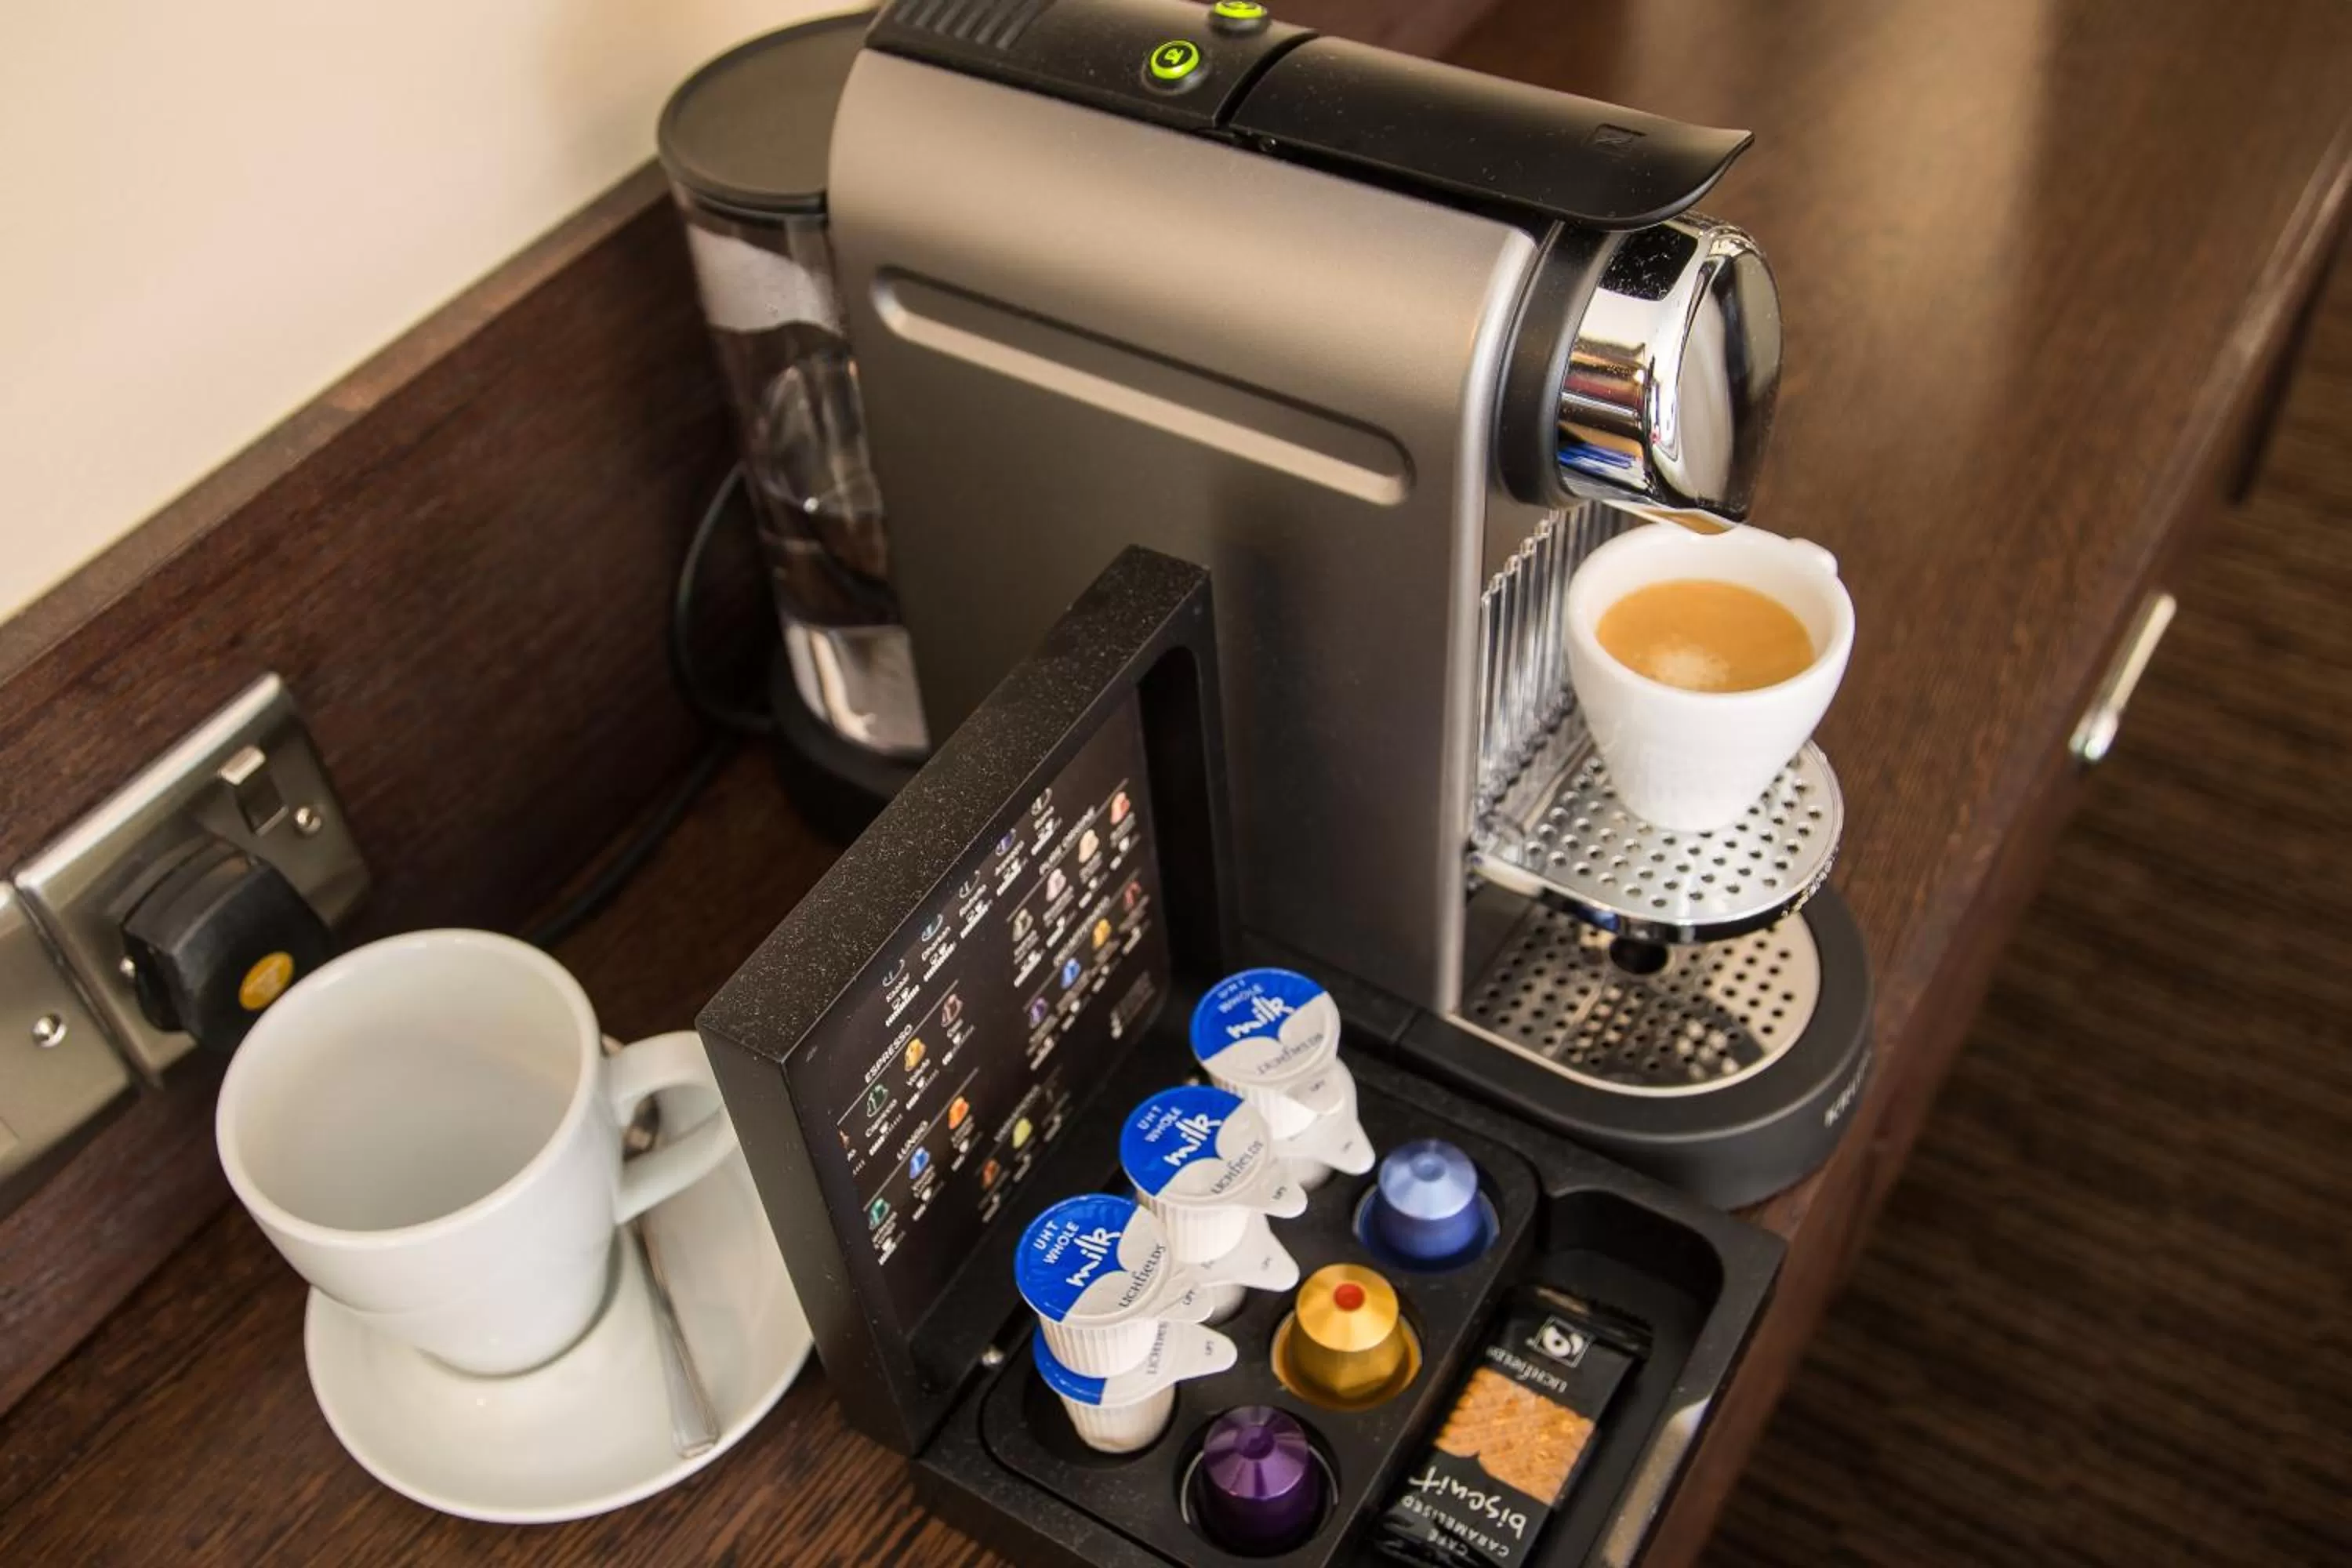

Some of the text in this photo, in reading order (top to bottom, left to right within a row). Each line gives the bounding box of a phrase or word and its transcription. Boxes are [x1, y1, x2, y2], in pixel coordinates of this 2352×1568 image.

[1225, 996, 1296, 1039] milk
[865, 1023, 913, 1083] ESPRESSO
[1137, 1105, 1162, 1130] UHT
[1163, 1113, 1223, 1167] milk
[1033, 1220, 1059, 1250] UHT
[1043, 1221, 1080, 1265] WHOLE
[1065, 1227, 1123, 1287] milk
[1401, 1494, 1510, 1558] CARAMELISED
[1408, 1465, 1527, 1541] biscuit
